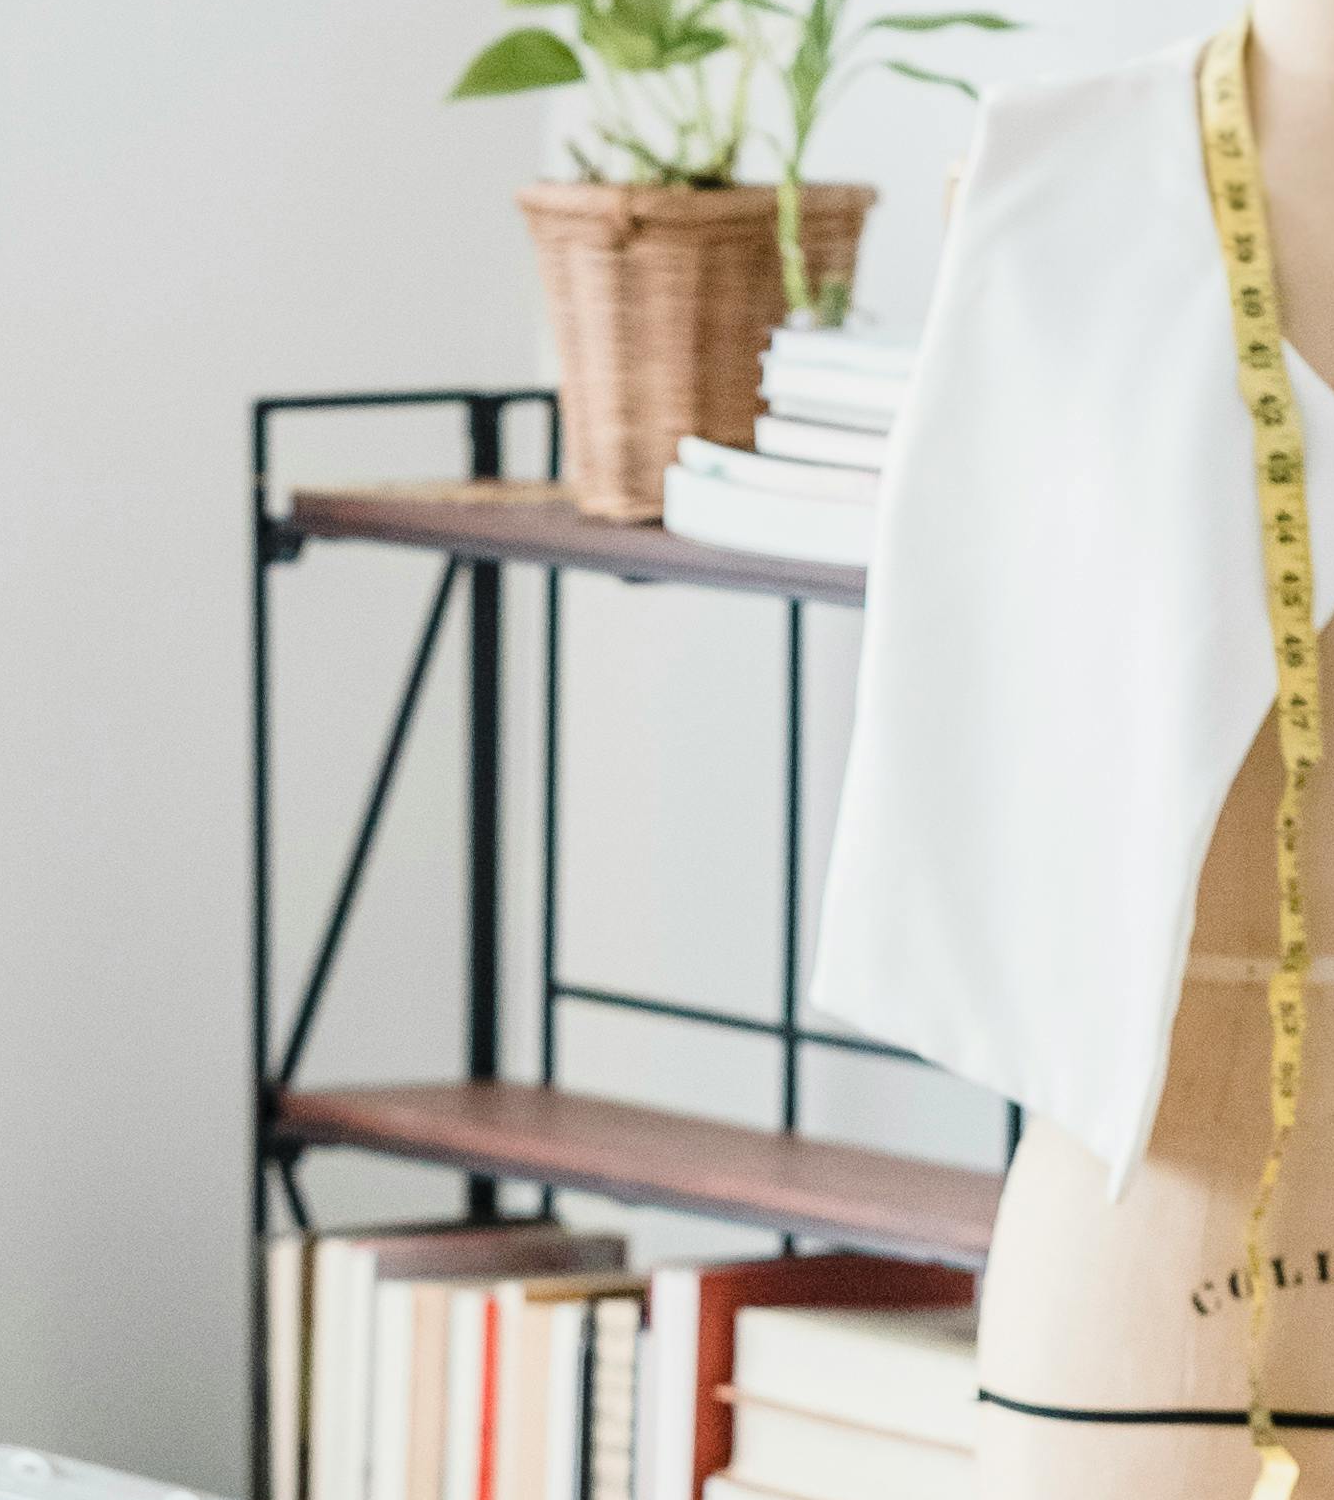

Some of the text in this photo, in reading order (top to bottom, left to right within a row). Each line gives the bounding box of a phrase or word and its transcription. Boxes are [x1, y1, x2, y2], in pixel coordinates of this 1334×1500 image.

[1241, 287, 1266, 318] 40
[1275, 509, 1298, 545] 44
[1289, 693, 1310, 731] 47
